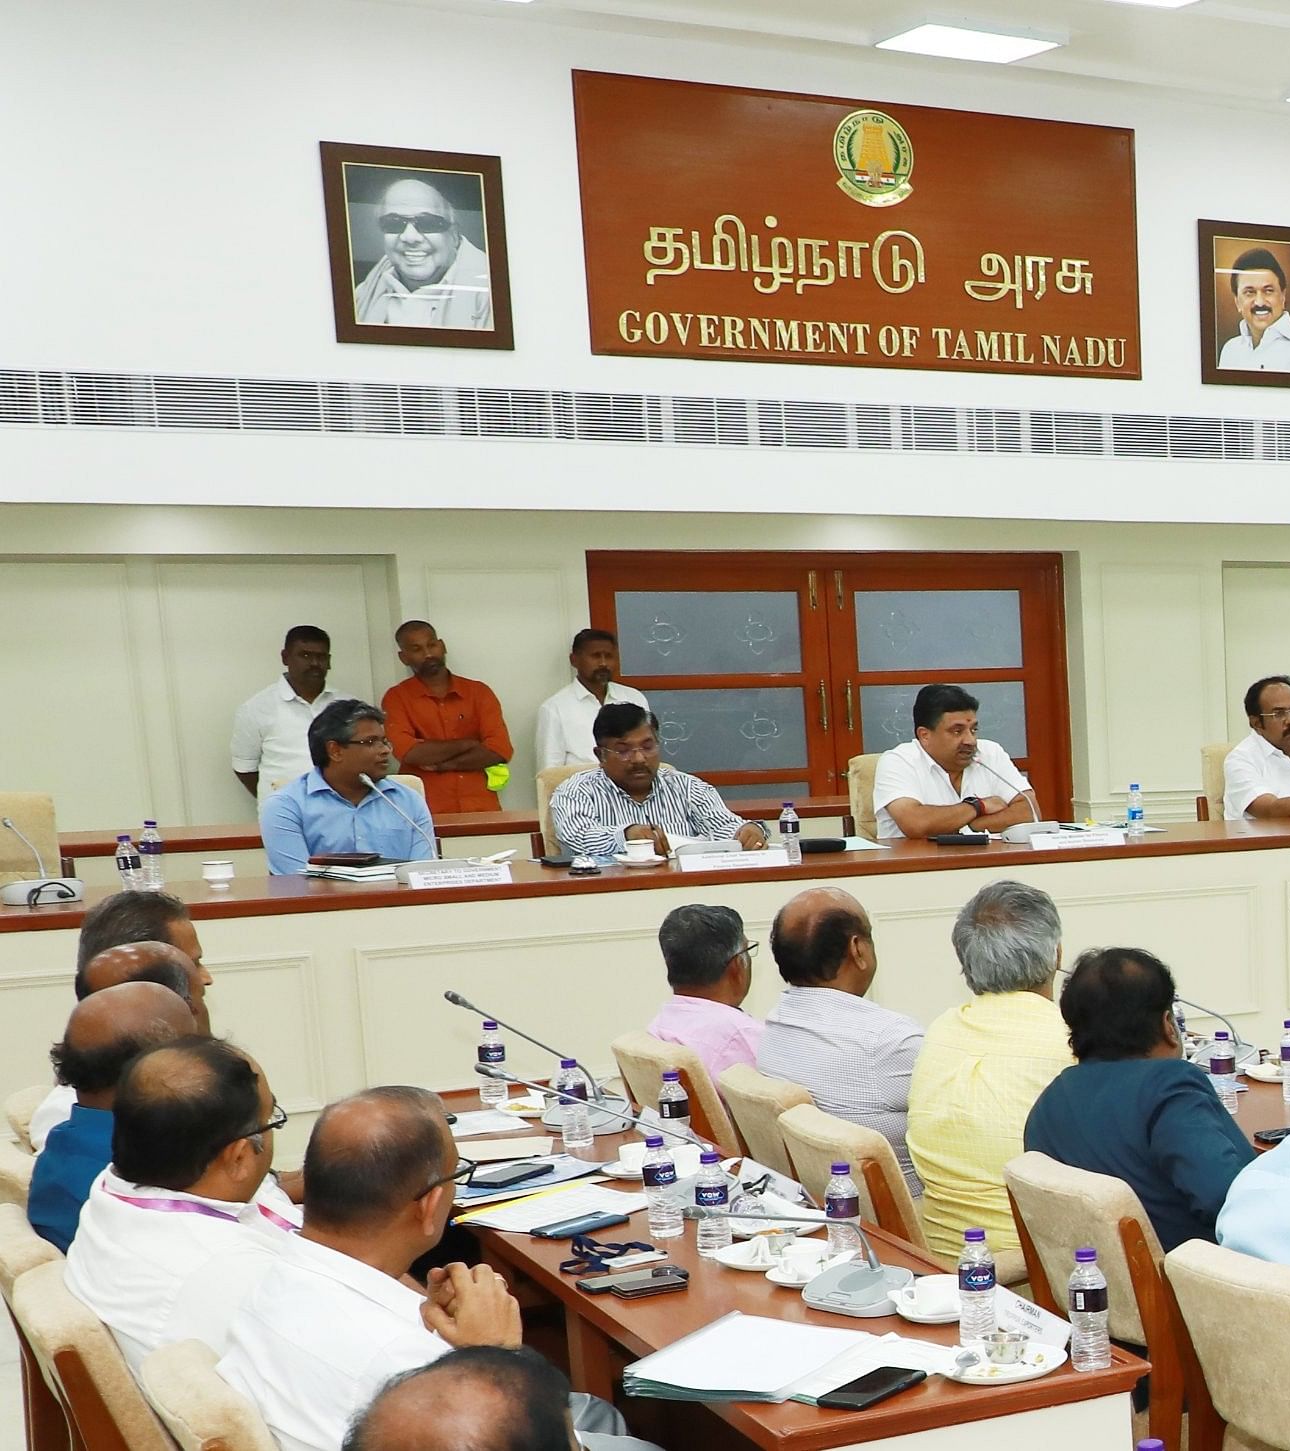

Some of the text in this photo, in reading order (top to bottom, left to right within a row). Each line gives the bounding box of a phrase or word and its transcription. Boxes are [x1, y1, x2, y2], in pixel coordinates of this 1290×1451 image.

[643, 214, 1095, 309] தமிழ்நாடு அரசு
[618, 310, 1127, 369] GOVERNMENT OF TAMIL NADU
[701, 1192, 720, 1200] VOW
[1015, 1300, 1041, 1320] CHAIRMAN
